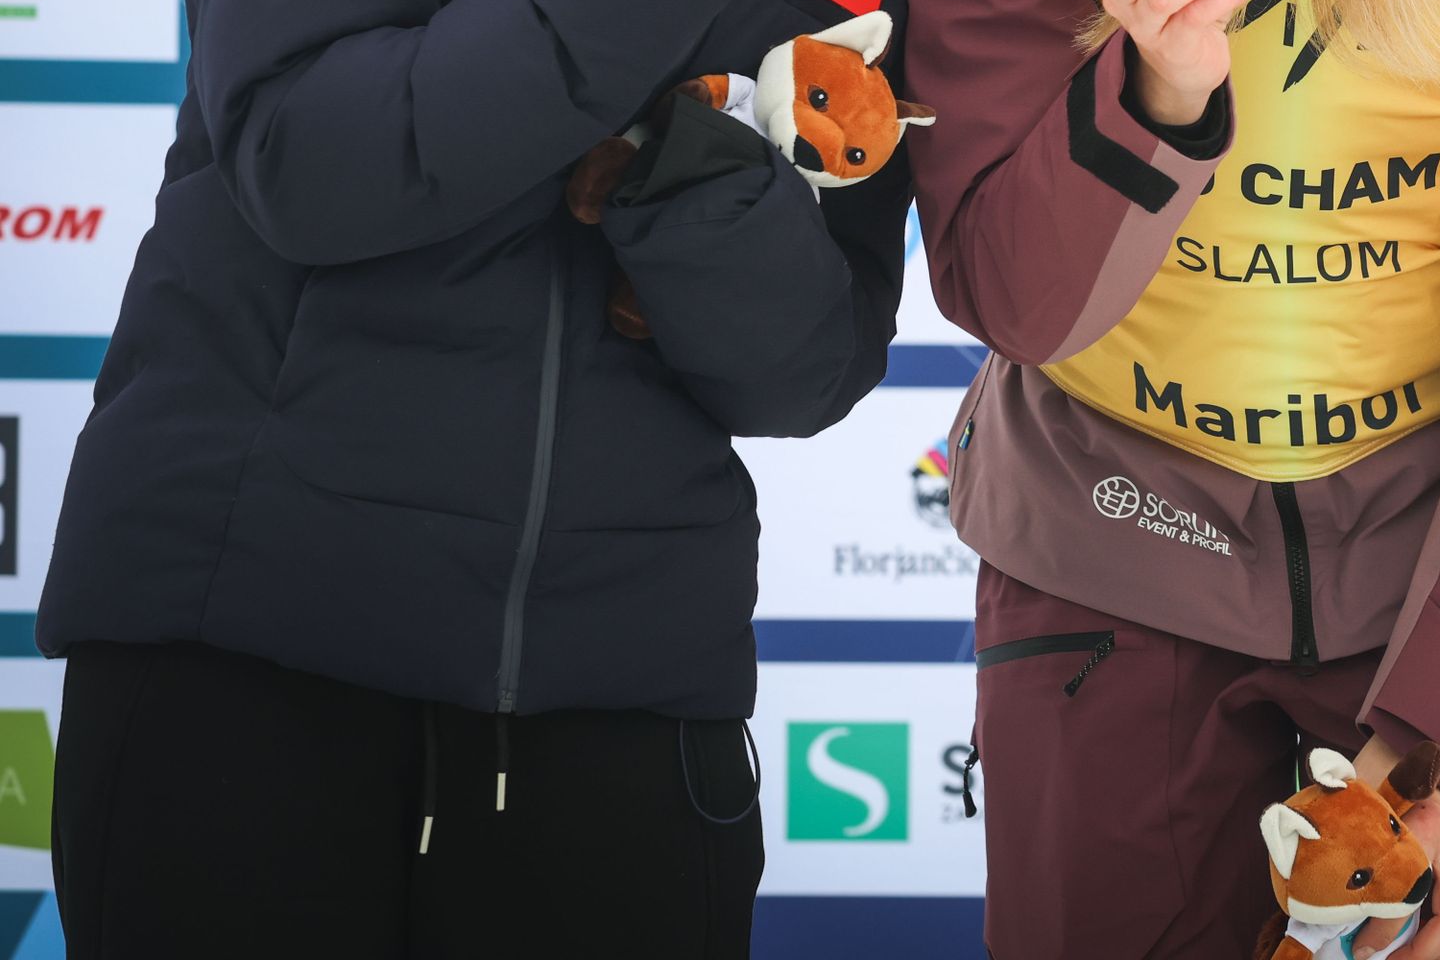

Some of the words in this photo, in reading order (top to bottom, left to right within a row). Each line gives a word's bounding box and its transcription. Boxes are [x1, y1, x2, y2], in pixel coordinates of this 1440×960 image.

[1177, 237, 1402, 284] SLALOM
[1137, 517, 1179, 539] EVENT
[1179, 530, 1190, 543] &
[1192, 534, 1232, 556] PROFIL
